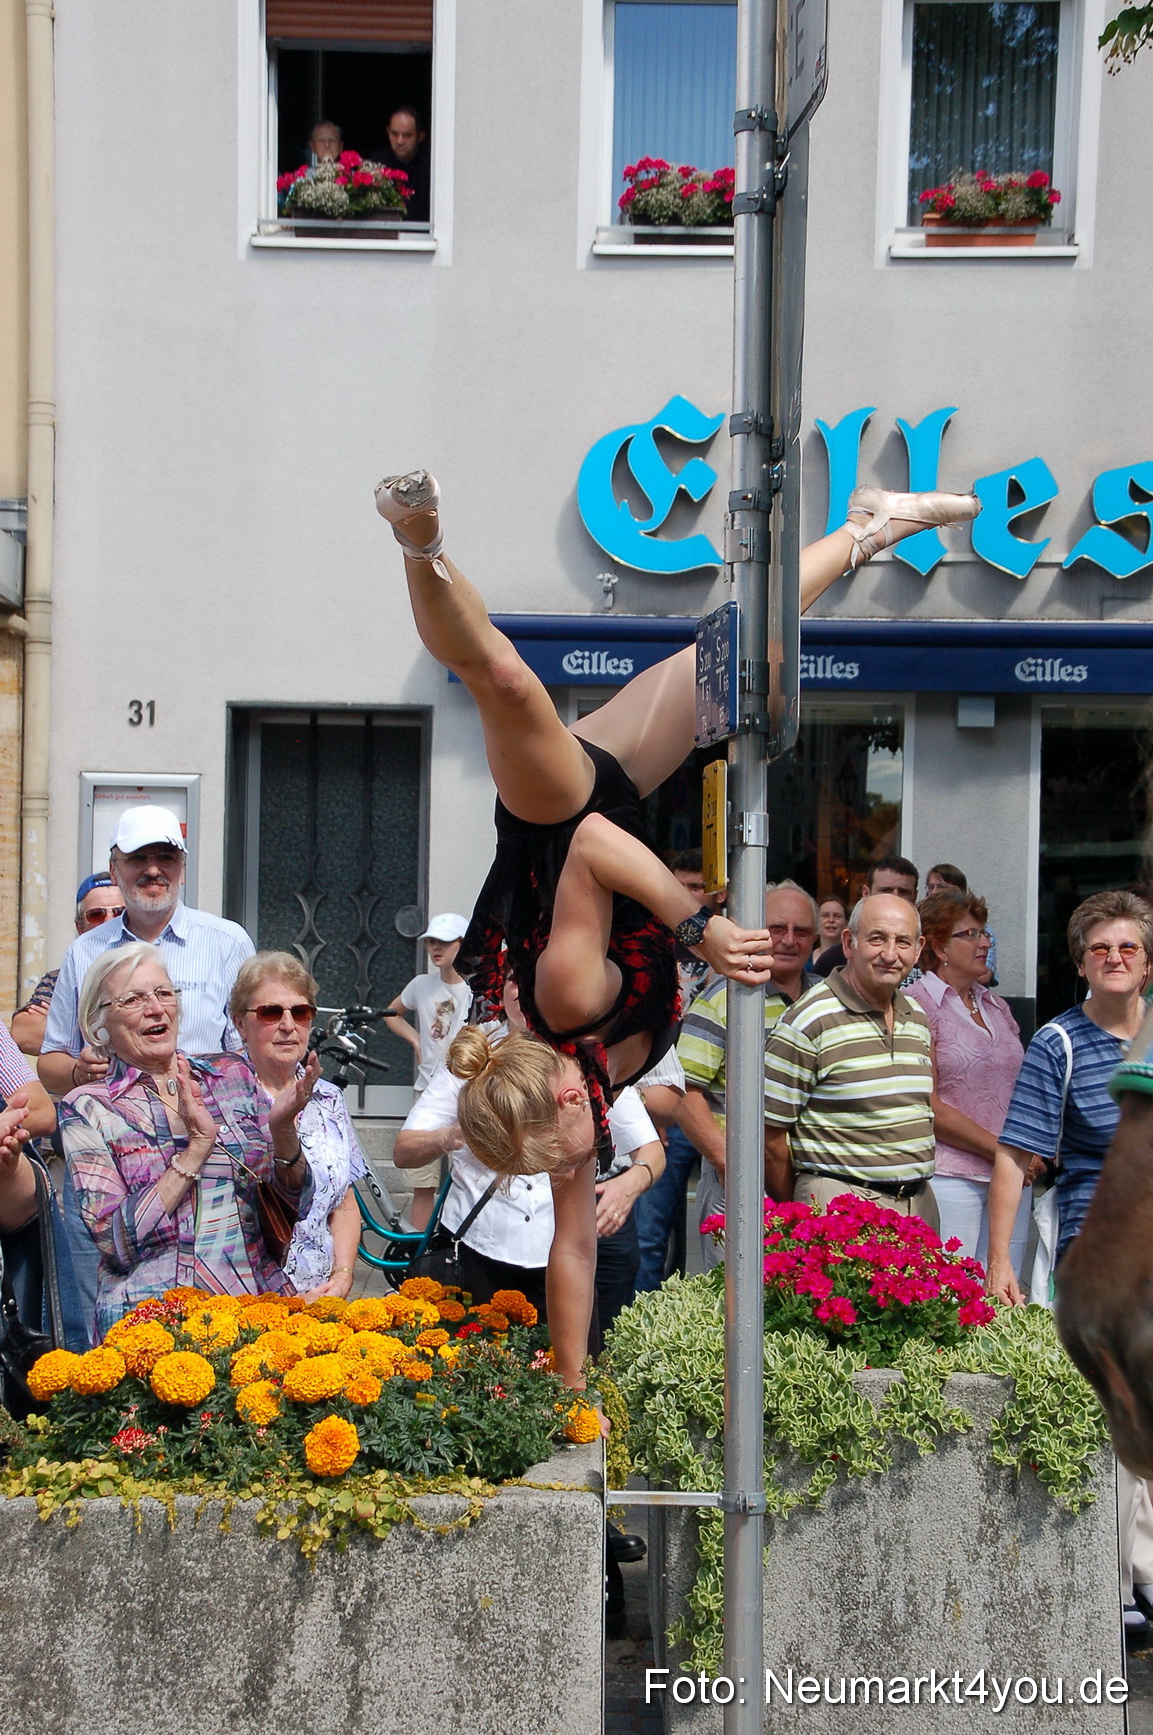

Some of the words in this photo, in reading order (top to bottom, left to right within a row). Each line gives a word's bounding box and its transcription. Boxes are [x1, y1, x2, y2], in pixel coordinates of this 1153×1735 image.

[577, 394, 1153, 579] Elles
[562, 649, 634, 676] Eilles
[1014, 656, 1088, 683] Eilles
[128, 699, 156, 727] 31
